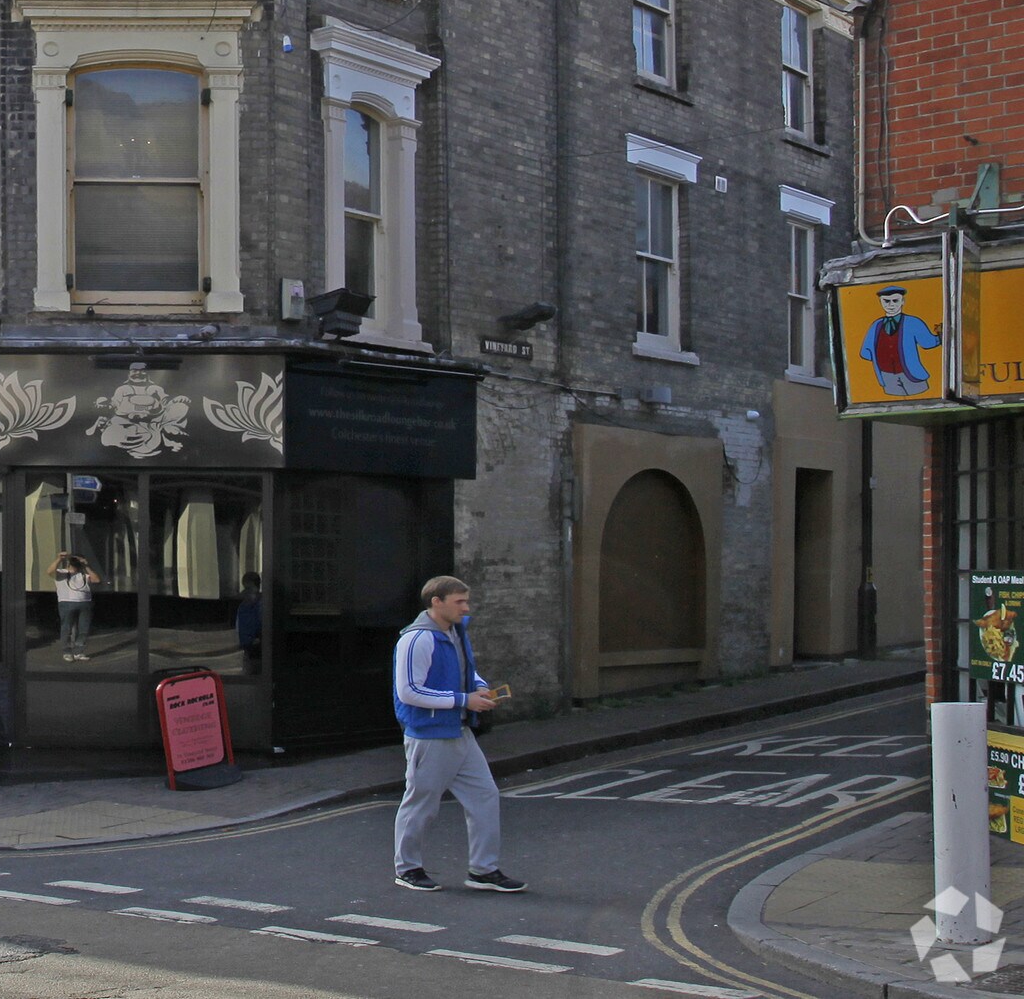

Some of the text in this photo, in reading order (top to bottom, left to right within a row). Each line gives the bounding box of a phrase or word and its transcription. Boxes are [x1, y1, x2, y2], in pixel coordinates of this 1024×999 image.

[484, 340, 530, 356] VINEYARD ST
[972, 575, 992, 584] Student
[993, 576, 997, 584] &
[997, 575, 1010, 584] OAP
[992, 662, 1024, 683] £7.45
[990, 750, 1009, 763] £5.90
[499, 768, 917, 809] CLEAR
